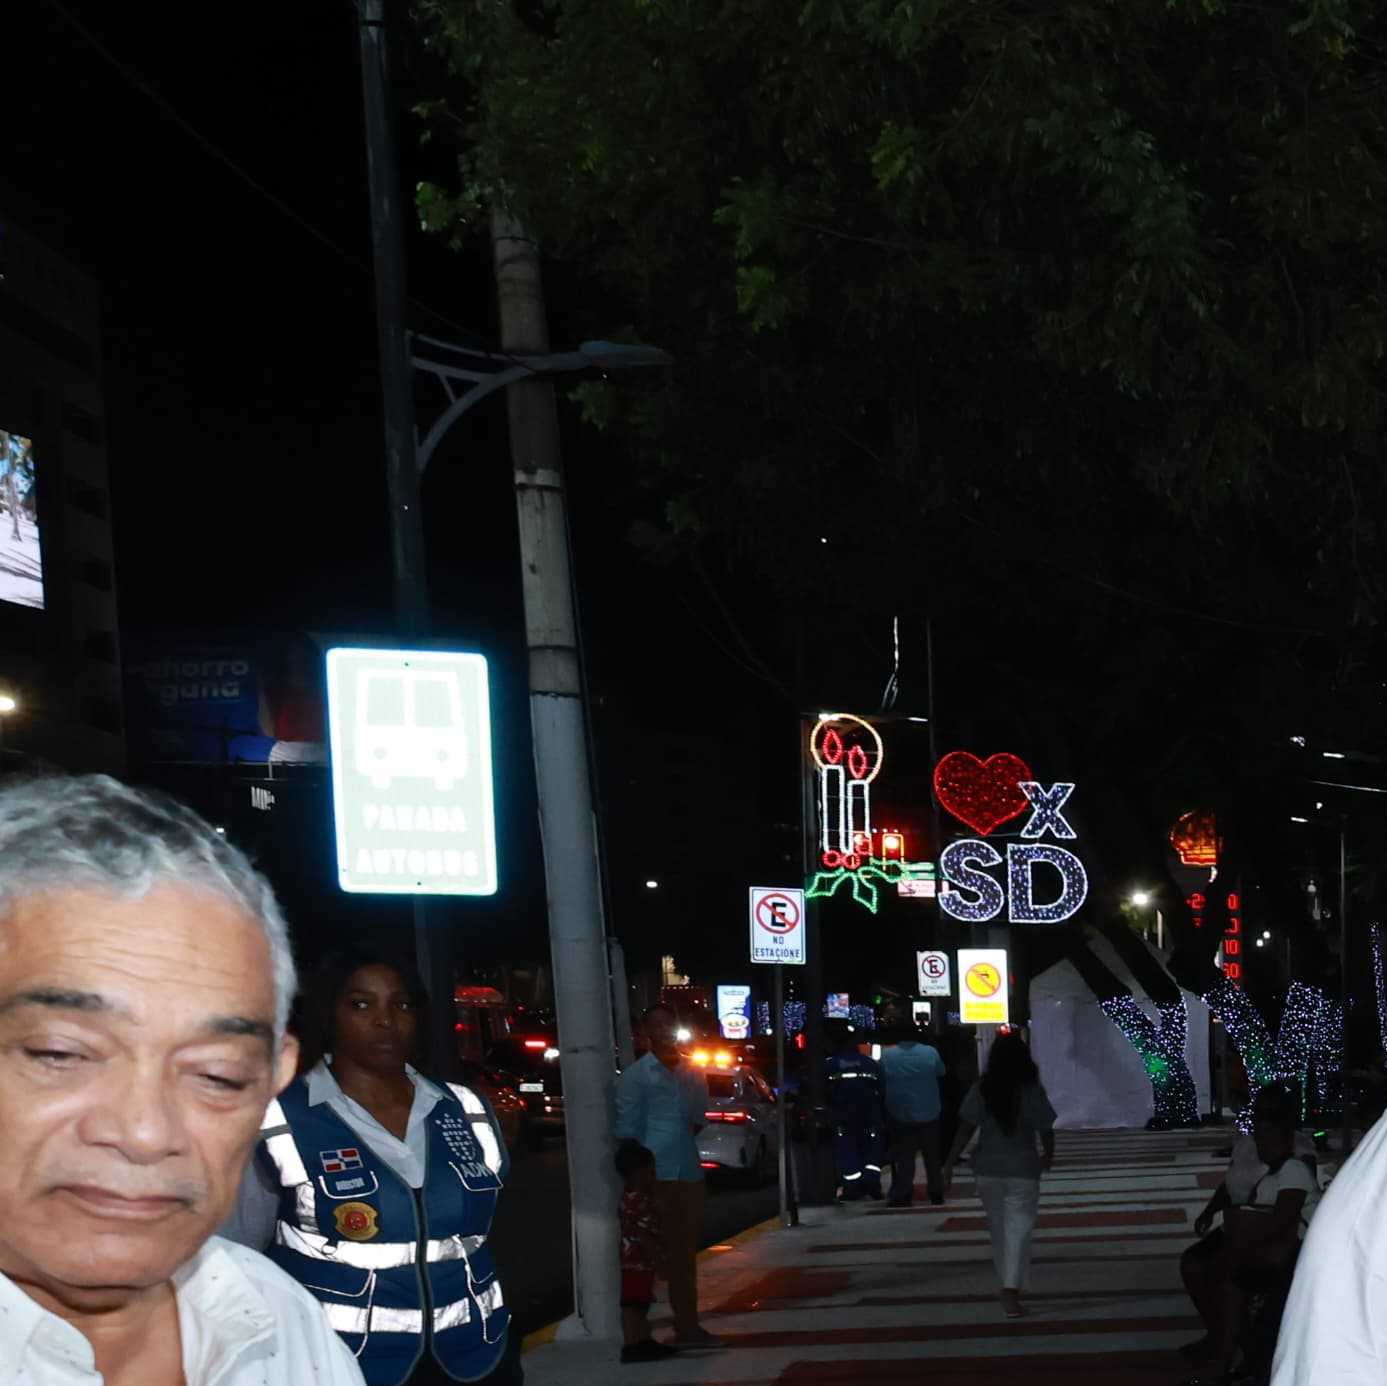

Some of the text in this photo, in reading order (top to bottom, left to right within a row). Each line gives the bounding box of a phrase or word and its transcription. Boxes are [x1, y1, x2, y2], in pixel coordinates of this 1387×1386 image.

[160, 681, 240, 710] gana
[362, 802, 468, 833] PARADA
[355, 847, 480, 877] AUTOBUS
[938, 839, 1088, 923] SD
[755, 947, 800, 958] ESTACIONE
[772, 935, 785, 945] NO
